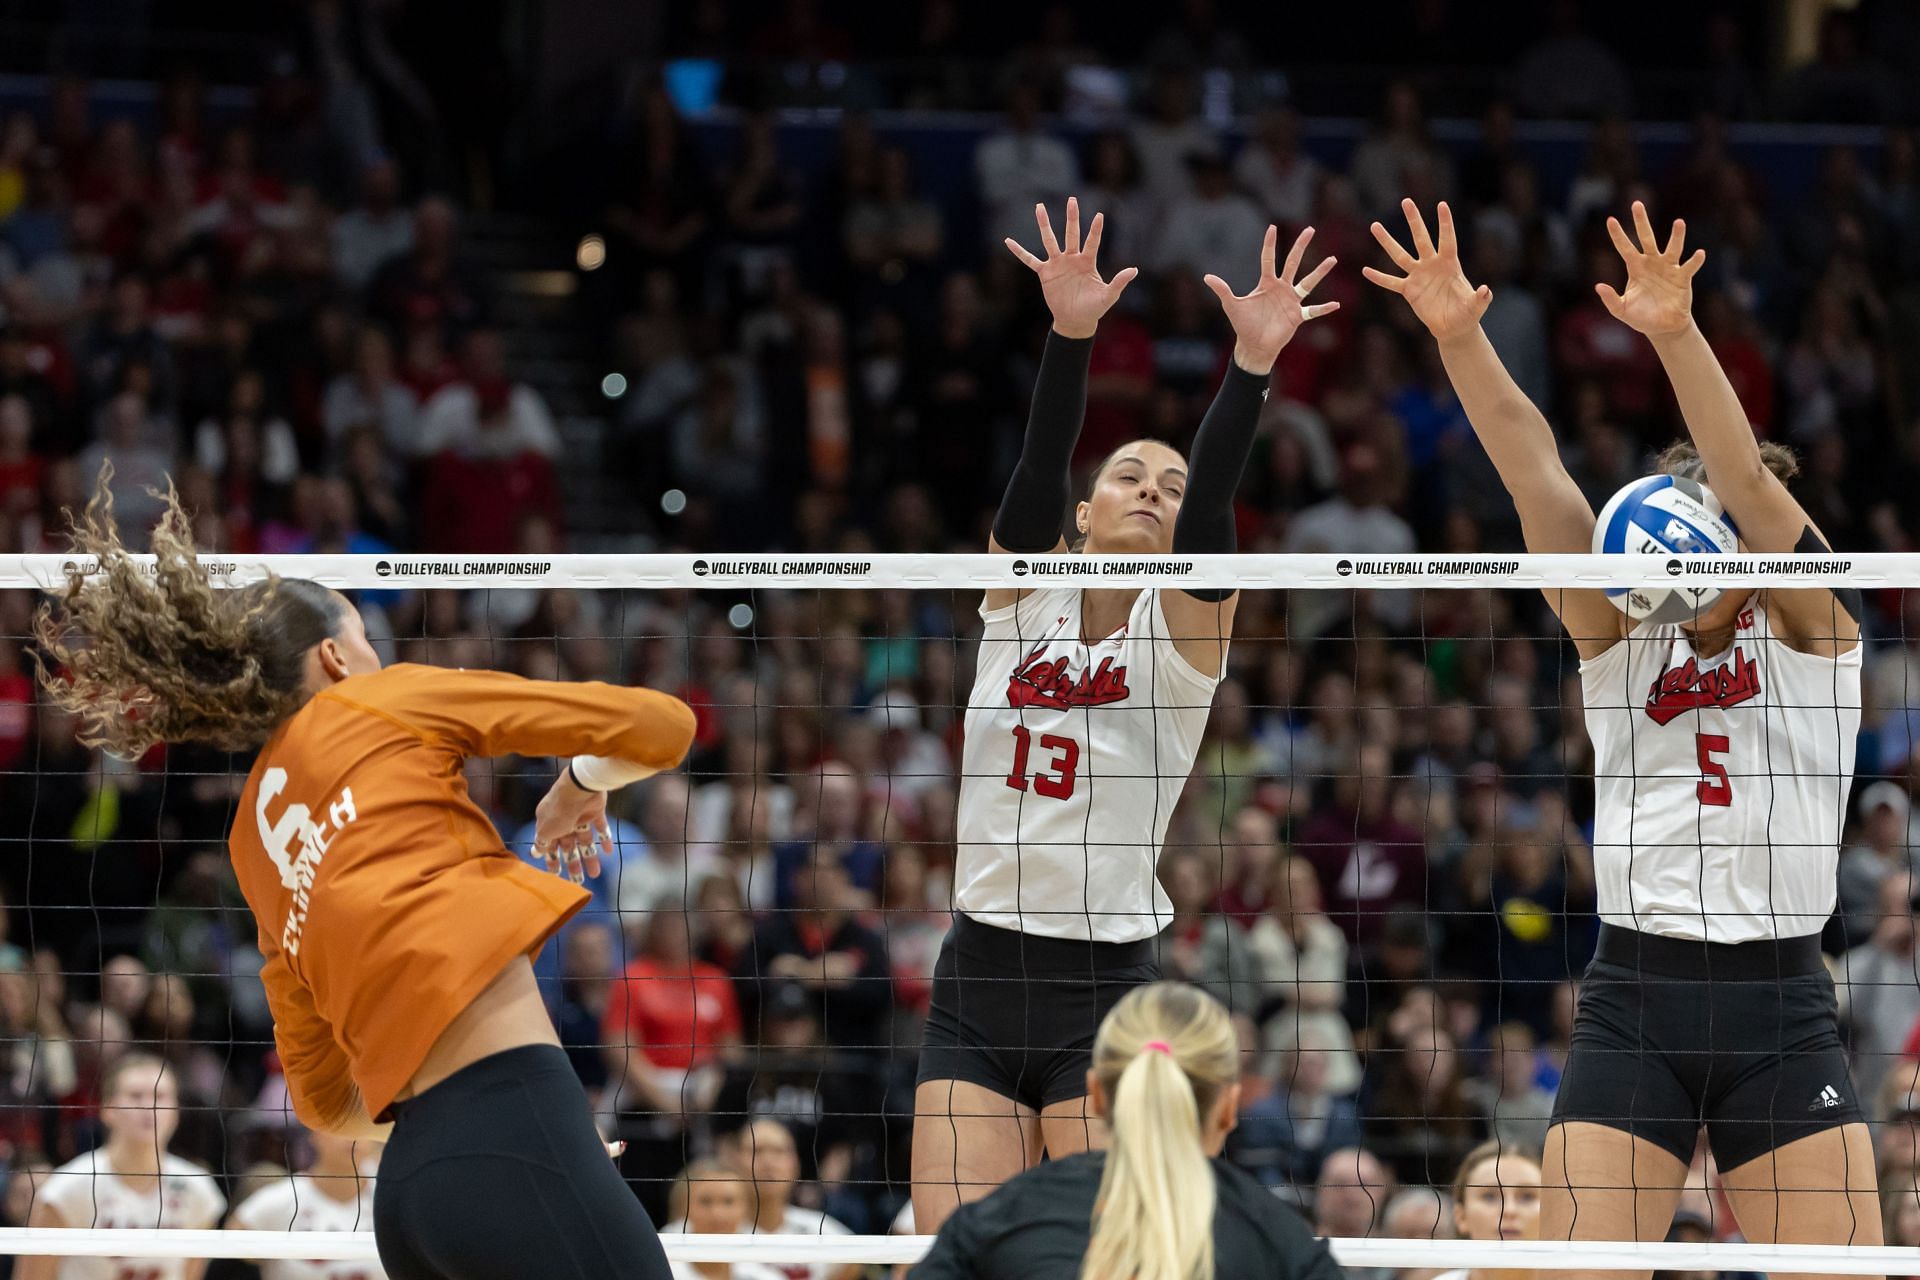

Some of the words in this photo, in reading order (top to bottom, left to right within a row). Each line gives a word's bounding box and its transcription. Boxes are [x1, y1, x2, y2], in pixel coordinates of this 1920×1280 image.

[394, 563, 460, 575] VOLLEYBALL
[463, 562, 551, 575] CHAMPIONSHIP
[711, 562, 778, 575] VOLLEYBALL
[782, 562, 871, 575] CHAMPIONSHIP
[1031, 562, 1099, 575] VOLLEYBALL
[1102, 562, 1193, 575] CHAMPIONSHIP
[1355, 561, 1424, 575] VOLLEYBALL
[1427, 561, 1519, 575] CHAMPIONSHIP
[1685, 561, 1755, 574] VOLLEYBALL
[1758, 561, 1852, 574] CHAMPIONSHIP
[1006, 724, 1080, 801] 13
[1695, 733, 1733, 807] 5
[256, 767, 312, 890] 6
